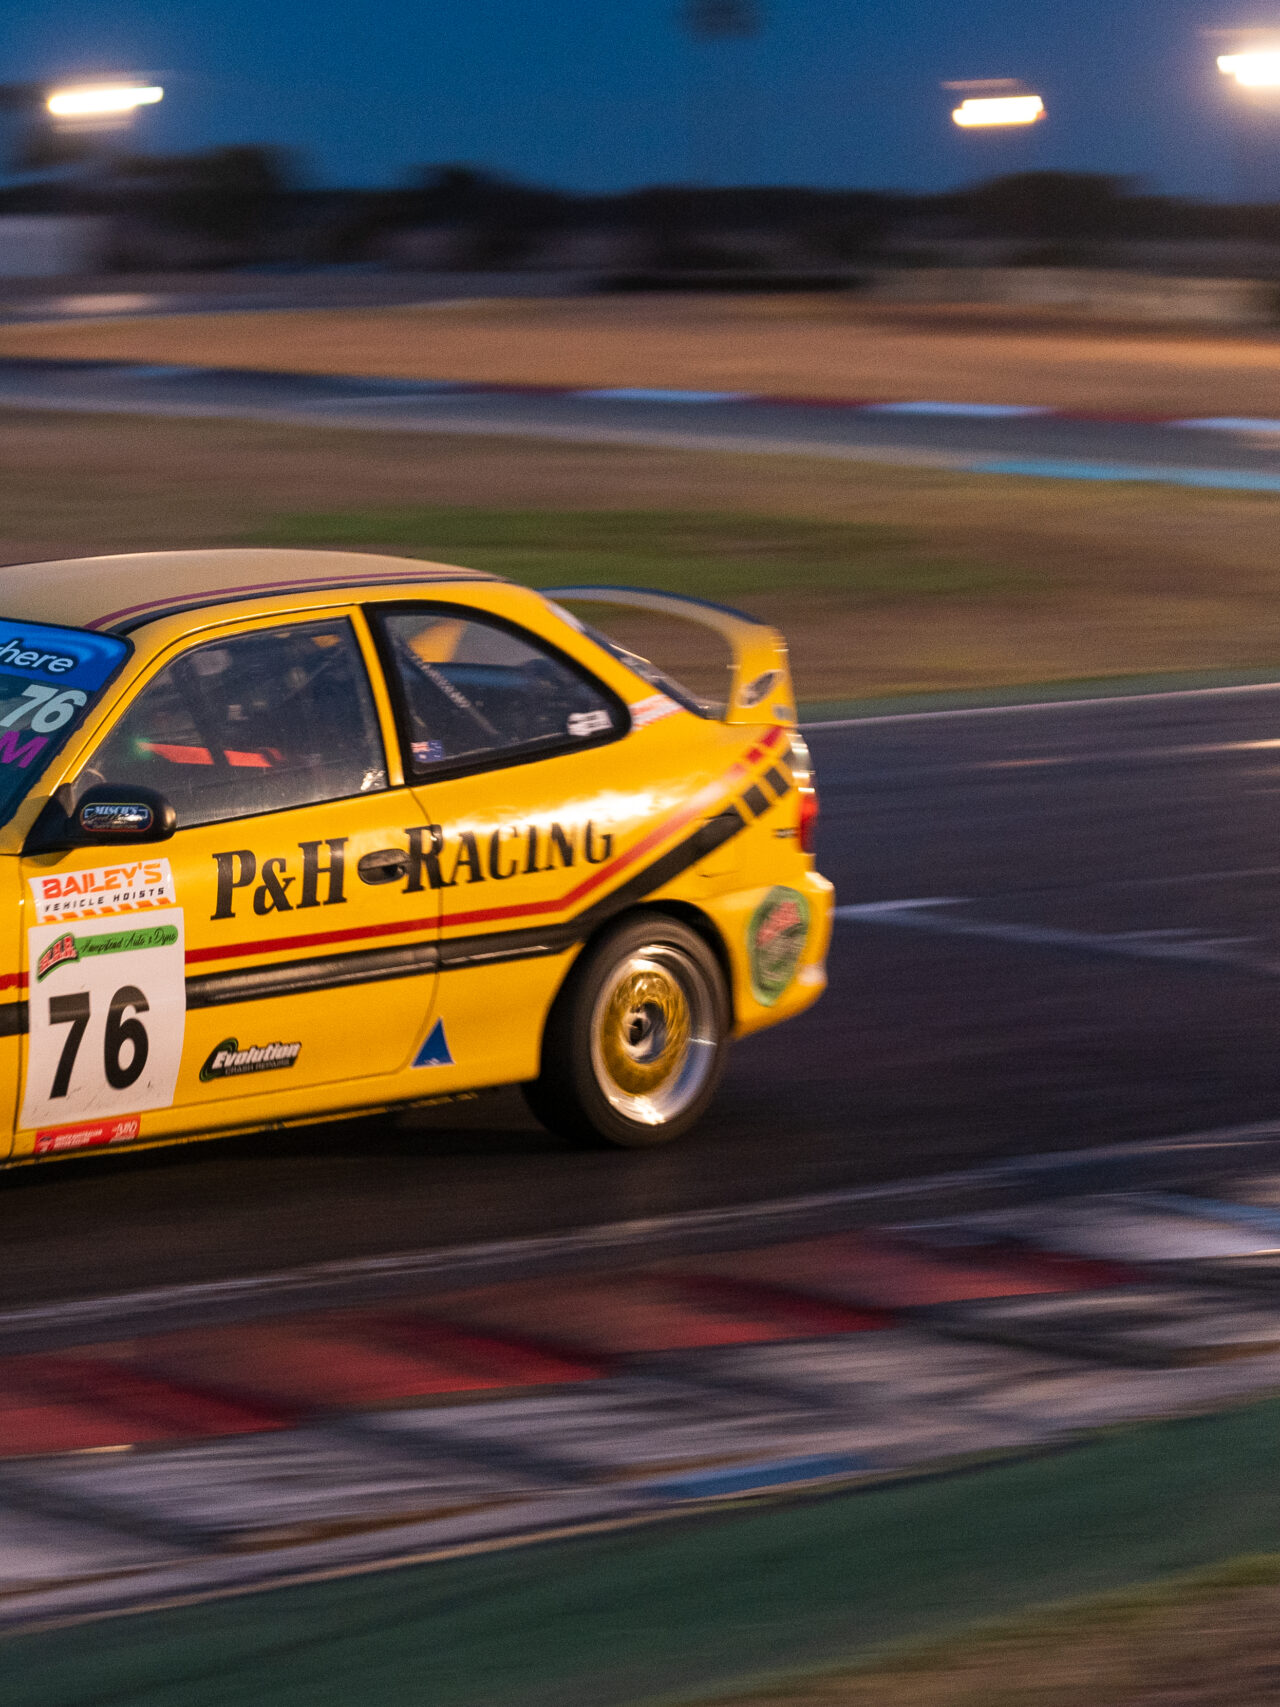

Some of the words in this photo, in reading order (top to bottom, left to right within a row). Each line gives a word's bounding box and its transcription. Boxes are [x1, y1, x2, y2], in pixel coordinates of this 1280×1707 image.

[42, 862, 163, 899] BAILEY'S
[210, 836, 350, 921] P&H
[401, 818, 615, 895] RACING
[45, 896, 105, 912] VEHICLE
[112, 886, 165, 902] HOISTS
[48, 985, 150, 1100] 76
[211, 1042, 302, 1070] Evolution
